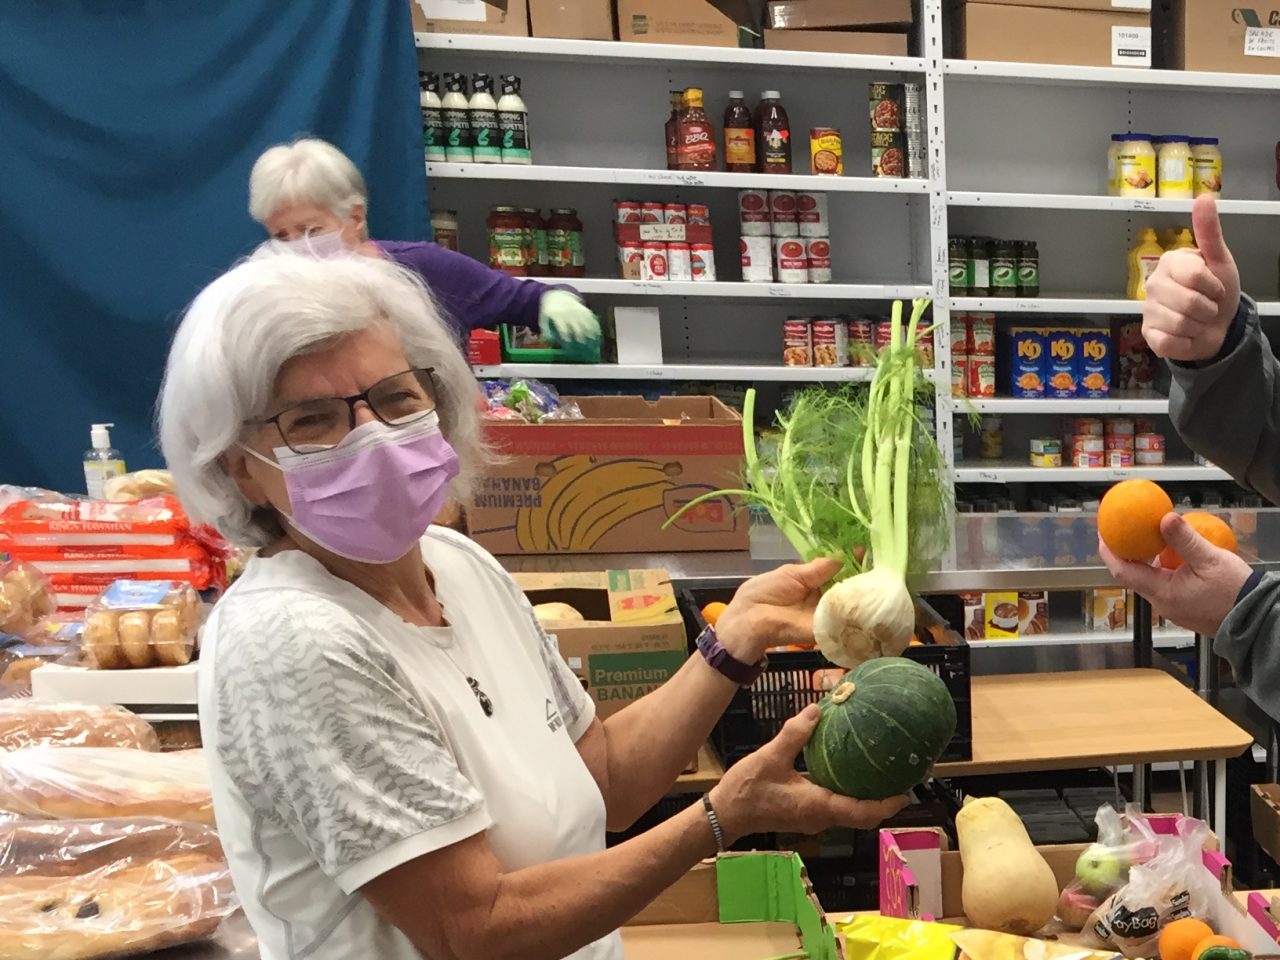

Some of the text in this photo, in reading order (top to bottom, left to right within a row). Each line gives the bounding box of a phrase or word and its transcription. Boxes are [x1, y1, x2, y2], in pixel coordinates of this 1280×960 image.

[684, 131, 710, 145] BBQ
[1018, 339, 1042, 360] KD
[1051, 339, 1075, 360] KD
[1083, 340, 1106, 361] KD
[82, 521, 133, 531] HAWAIIAN
[595, 667, 669, 683] Premium
